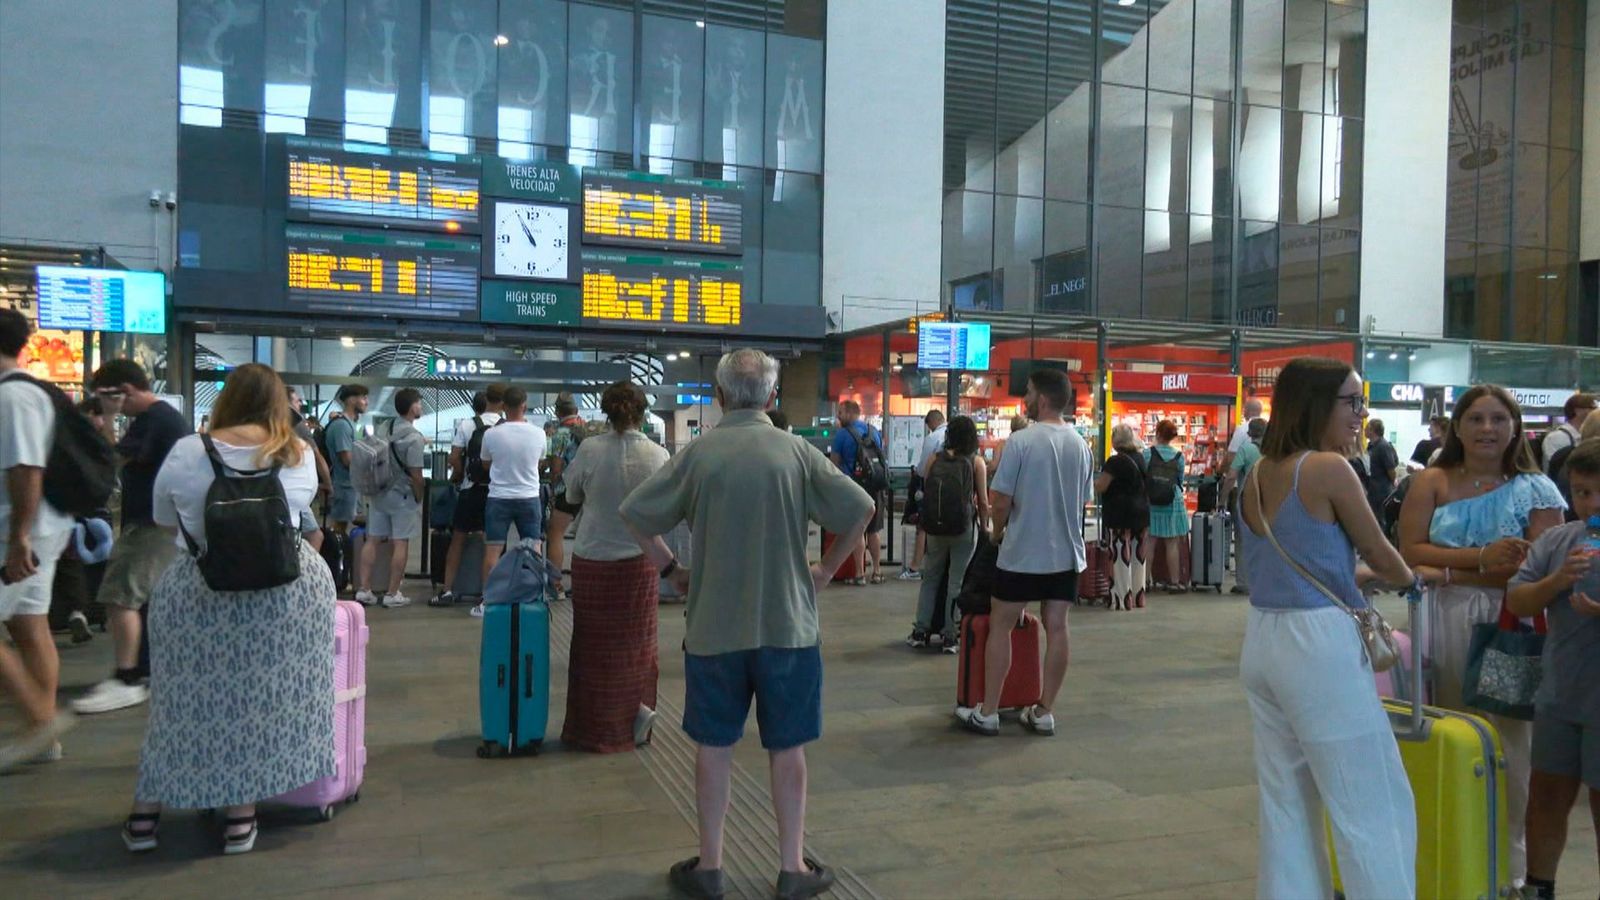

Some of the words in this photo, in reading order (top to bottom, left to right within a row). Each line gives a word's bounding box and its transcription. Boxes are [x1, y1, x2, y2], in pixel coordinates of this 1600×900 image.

[506, 164, 537, 179] TRENES
[540, 168, 560, 182] ALTA
[510, 178, 556, 193] VELOCIDAD
[502, 234, 510, 244] 9
[553, 238, 562, 248] 3
[505, 290, 528, 304] HIGH
[531, 292, 557, 305] SPEED
[517, 304, 547, 317] TRAINS
[1162, 373, 1189, 391] RELAY
[1391, 384, 1454, 403] CHAE
[1510, 389, 1551, 405] lormar
[1429, 398, 1439, 421] A
